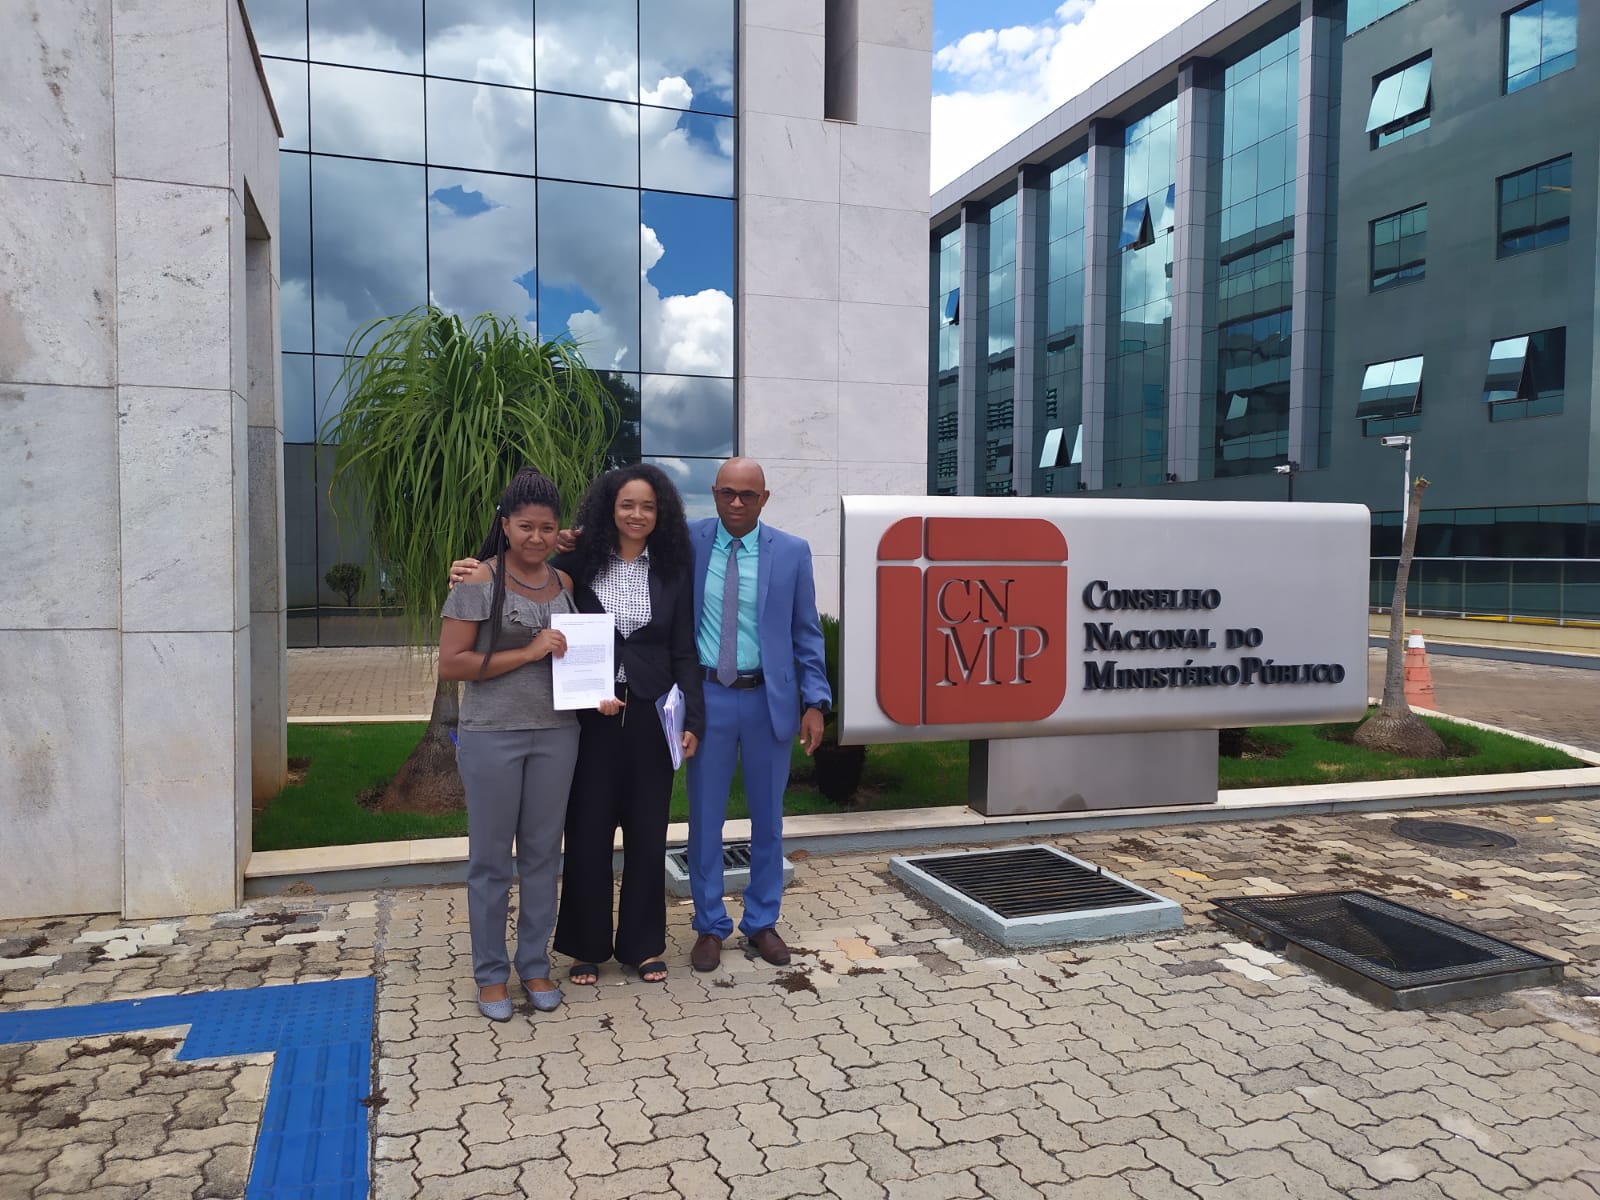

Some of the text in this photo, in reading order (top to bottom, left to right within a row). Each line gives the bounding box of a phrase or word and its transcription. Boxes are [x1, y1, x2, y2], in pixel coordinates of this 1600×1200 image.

[937, 578, 1015, 624] CN
[1082, 580, 1222, 611] CONSELHO
[1083, 622, 1264, 651] NACIONAL DO
[936, 626, 1050, 686] MP
[1083, 656, 1346, 690] MINISTÉRIO PÚBLICO
